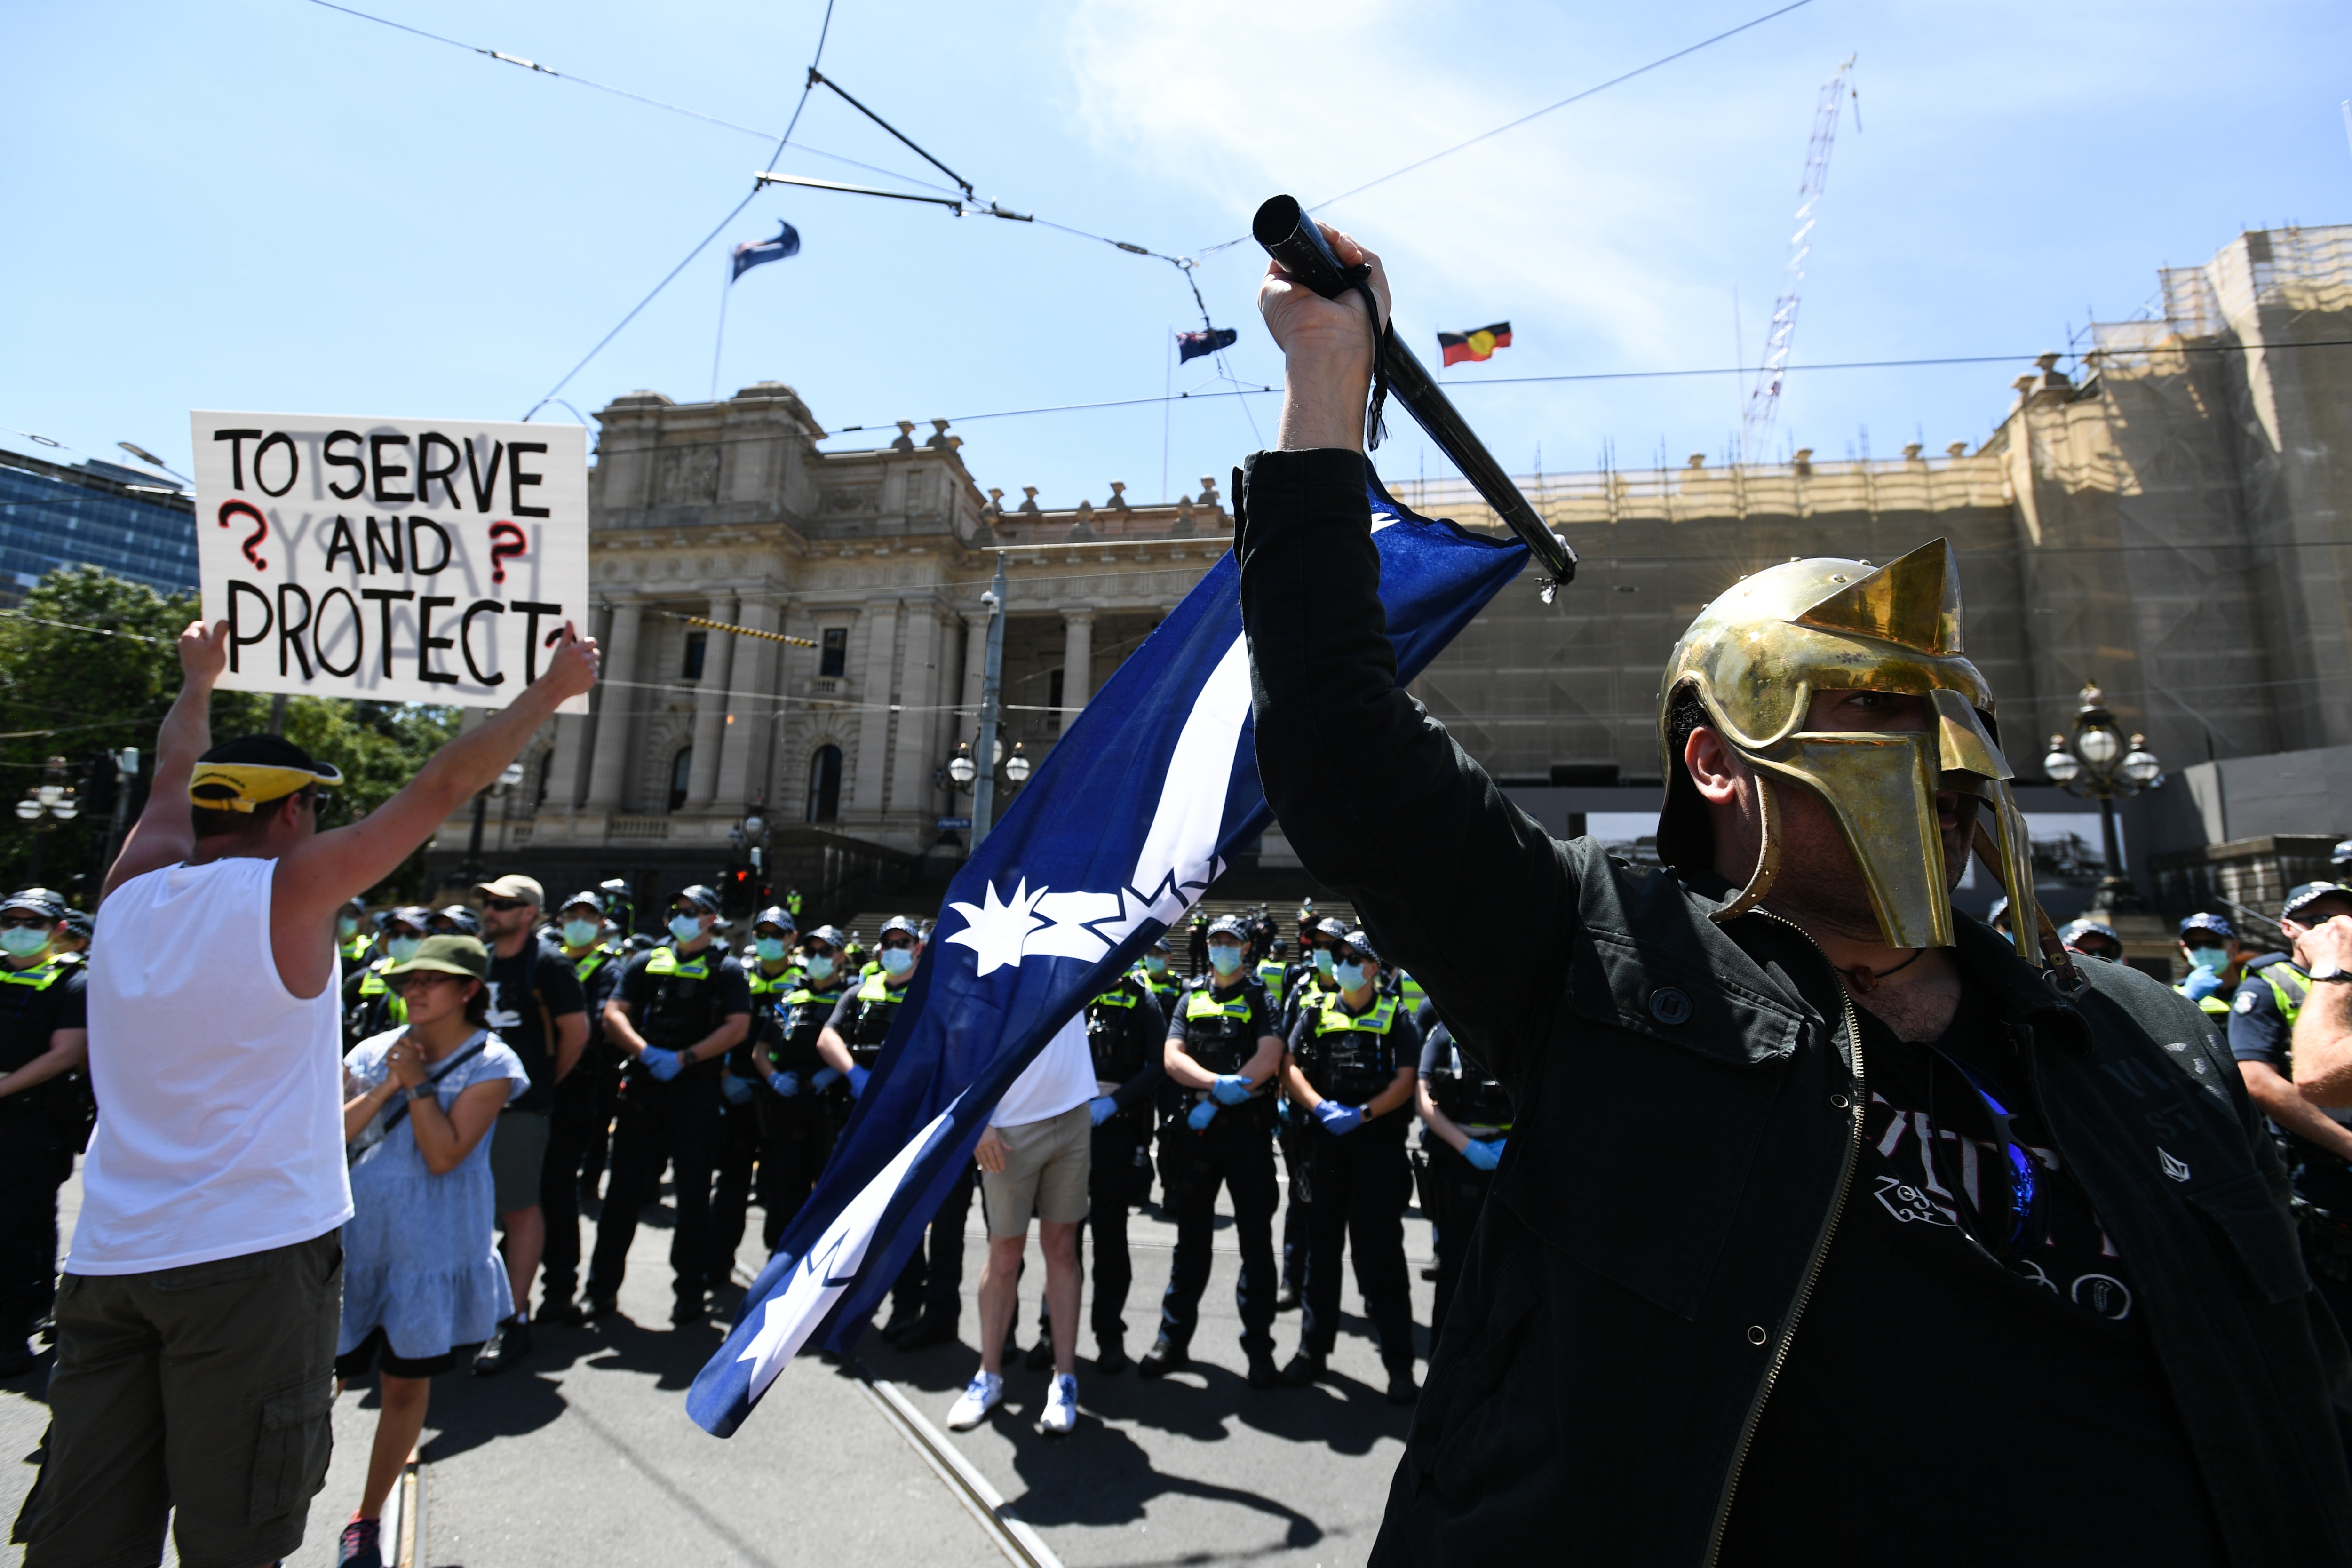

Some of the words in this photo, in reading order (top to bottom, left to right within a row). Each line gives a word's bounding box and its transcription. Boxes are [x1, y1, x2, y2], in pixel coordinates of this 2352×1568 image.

[214, 429, 299, 497] TO
[324, 430, 550, 518] SERVE
[218, 498, 269, 572] ?
[325, 514, 452, 576] AND
[488, 520, 527, 585] ?
[228, 579, 562, 686] PROTECT
